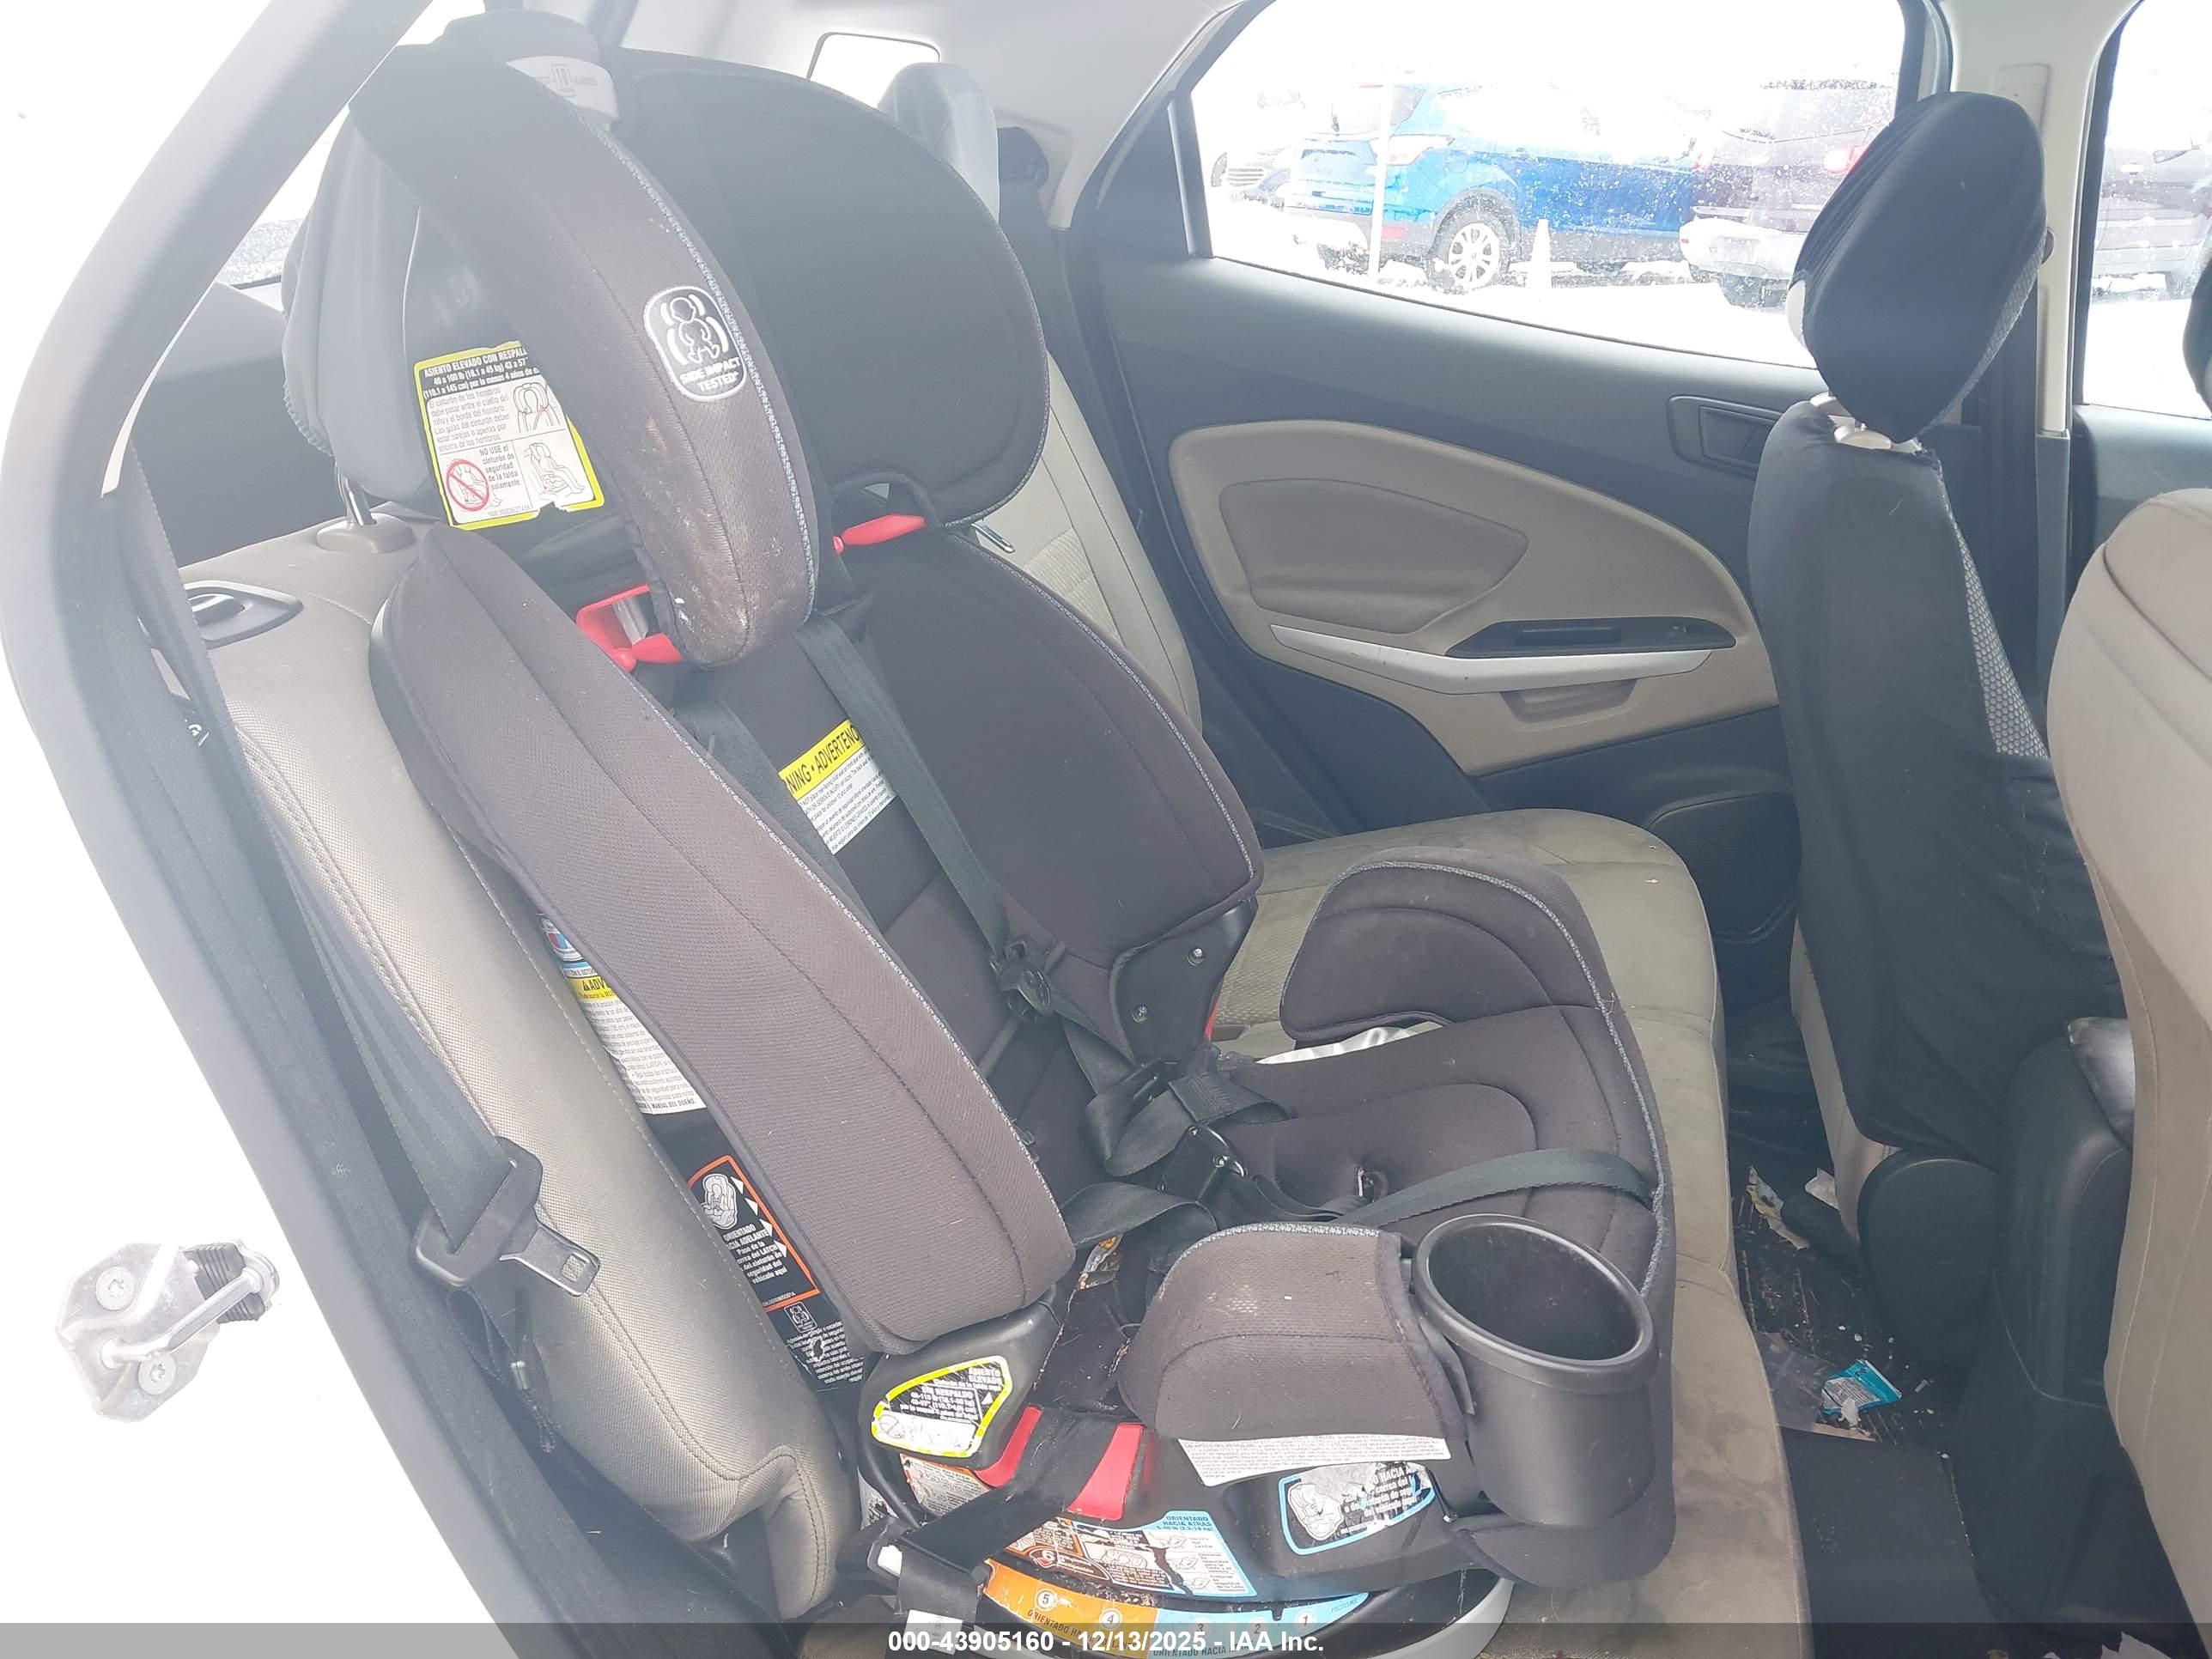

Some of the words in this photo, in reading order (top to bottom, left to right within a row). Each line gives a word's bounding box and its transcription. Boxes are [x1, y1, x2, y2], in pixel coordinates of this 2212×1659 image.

[423, 364, 451, 378] ASIENTO
[453, 356, 482, 371] ELEVADO
[482, 352, 497, 364] CON
[705, 356, 741, 376] IMPACT
[433, 376, 441, 386] 40
[503, 360, 513, 369] 43
[504, 371, 509, 380] 4
[489, 445, 501, 454] USE
[482, 453, 506, 465] cinturón
[485, 461, 514, 474] seguridad
[490, 478, 520, 490] solamente
[722, 1224, 756, 1241] ORIENTADO
[738, 1228, 769, 1245] ADELANTE
[1379, 1466, 1404, 1481] HACIA
[1165, 1513, 1208, 1522] ORIENTADO
[1042, 1594, 1049, 1605] 5
[1027, 1609, 1070, 1636] ORIENTADO
[1107, 1613, 1114, 1625] 4
[1201, 1645, 1226, 1656] HACIA
